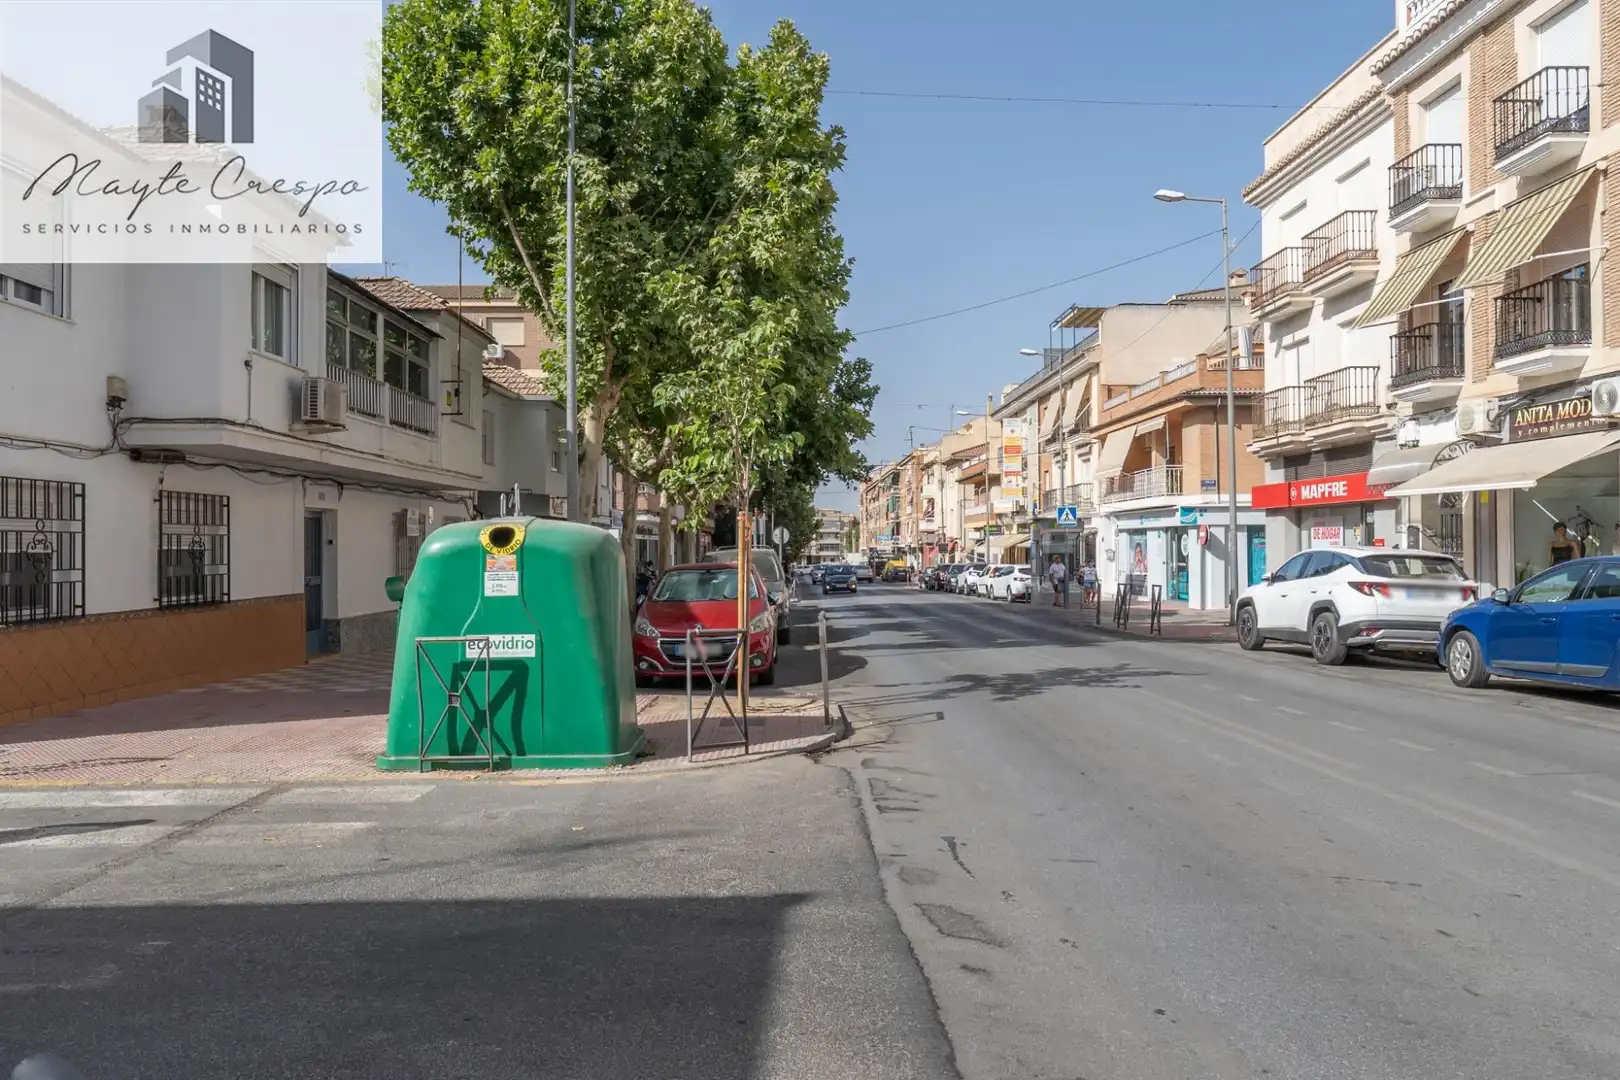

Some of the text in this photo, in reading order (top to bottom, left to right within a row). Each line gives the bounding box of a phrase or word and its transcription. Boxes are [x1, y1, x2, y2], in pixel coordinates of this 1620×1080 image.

[1514, 398, 1593, 426] ANITA MOD
[1518, 430, 1523, 438] y
[1301, 480, 1347, 500] MAPFRE
[1313, 527, 1341, 540] DE HOGAR
[485, 539, 521, 554] DE VIDRIO
[468, 636, 534, 650] ecovidrio
